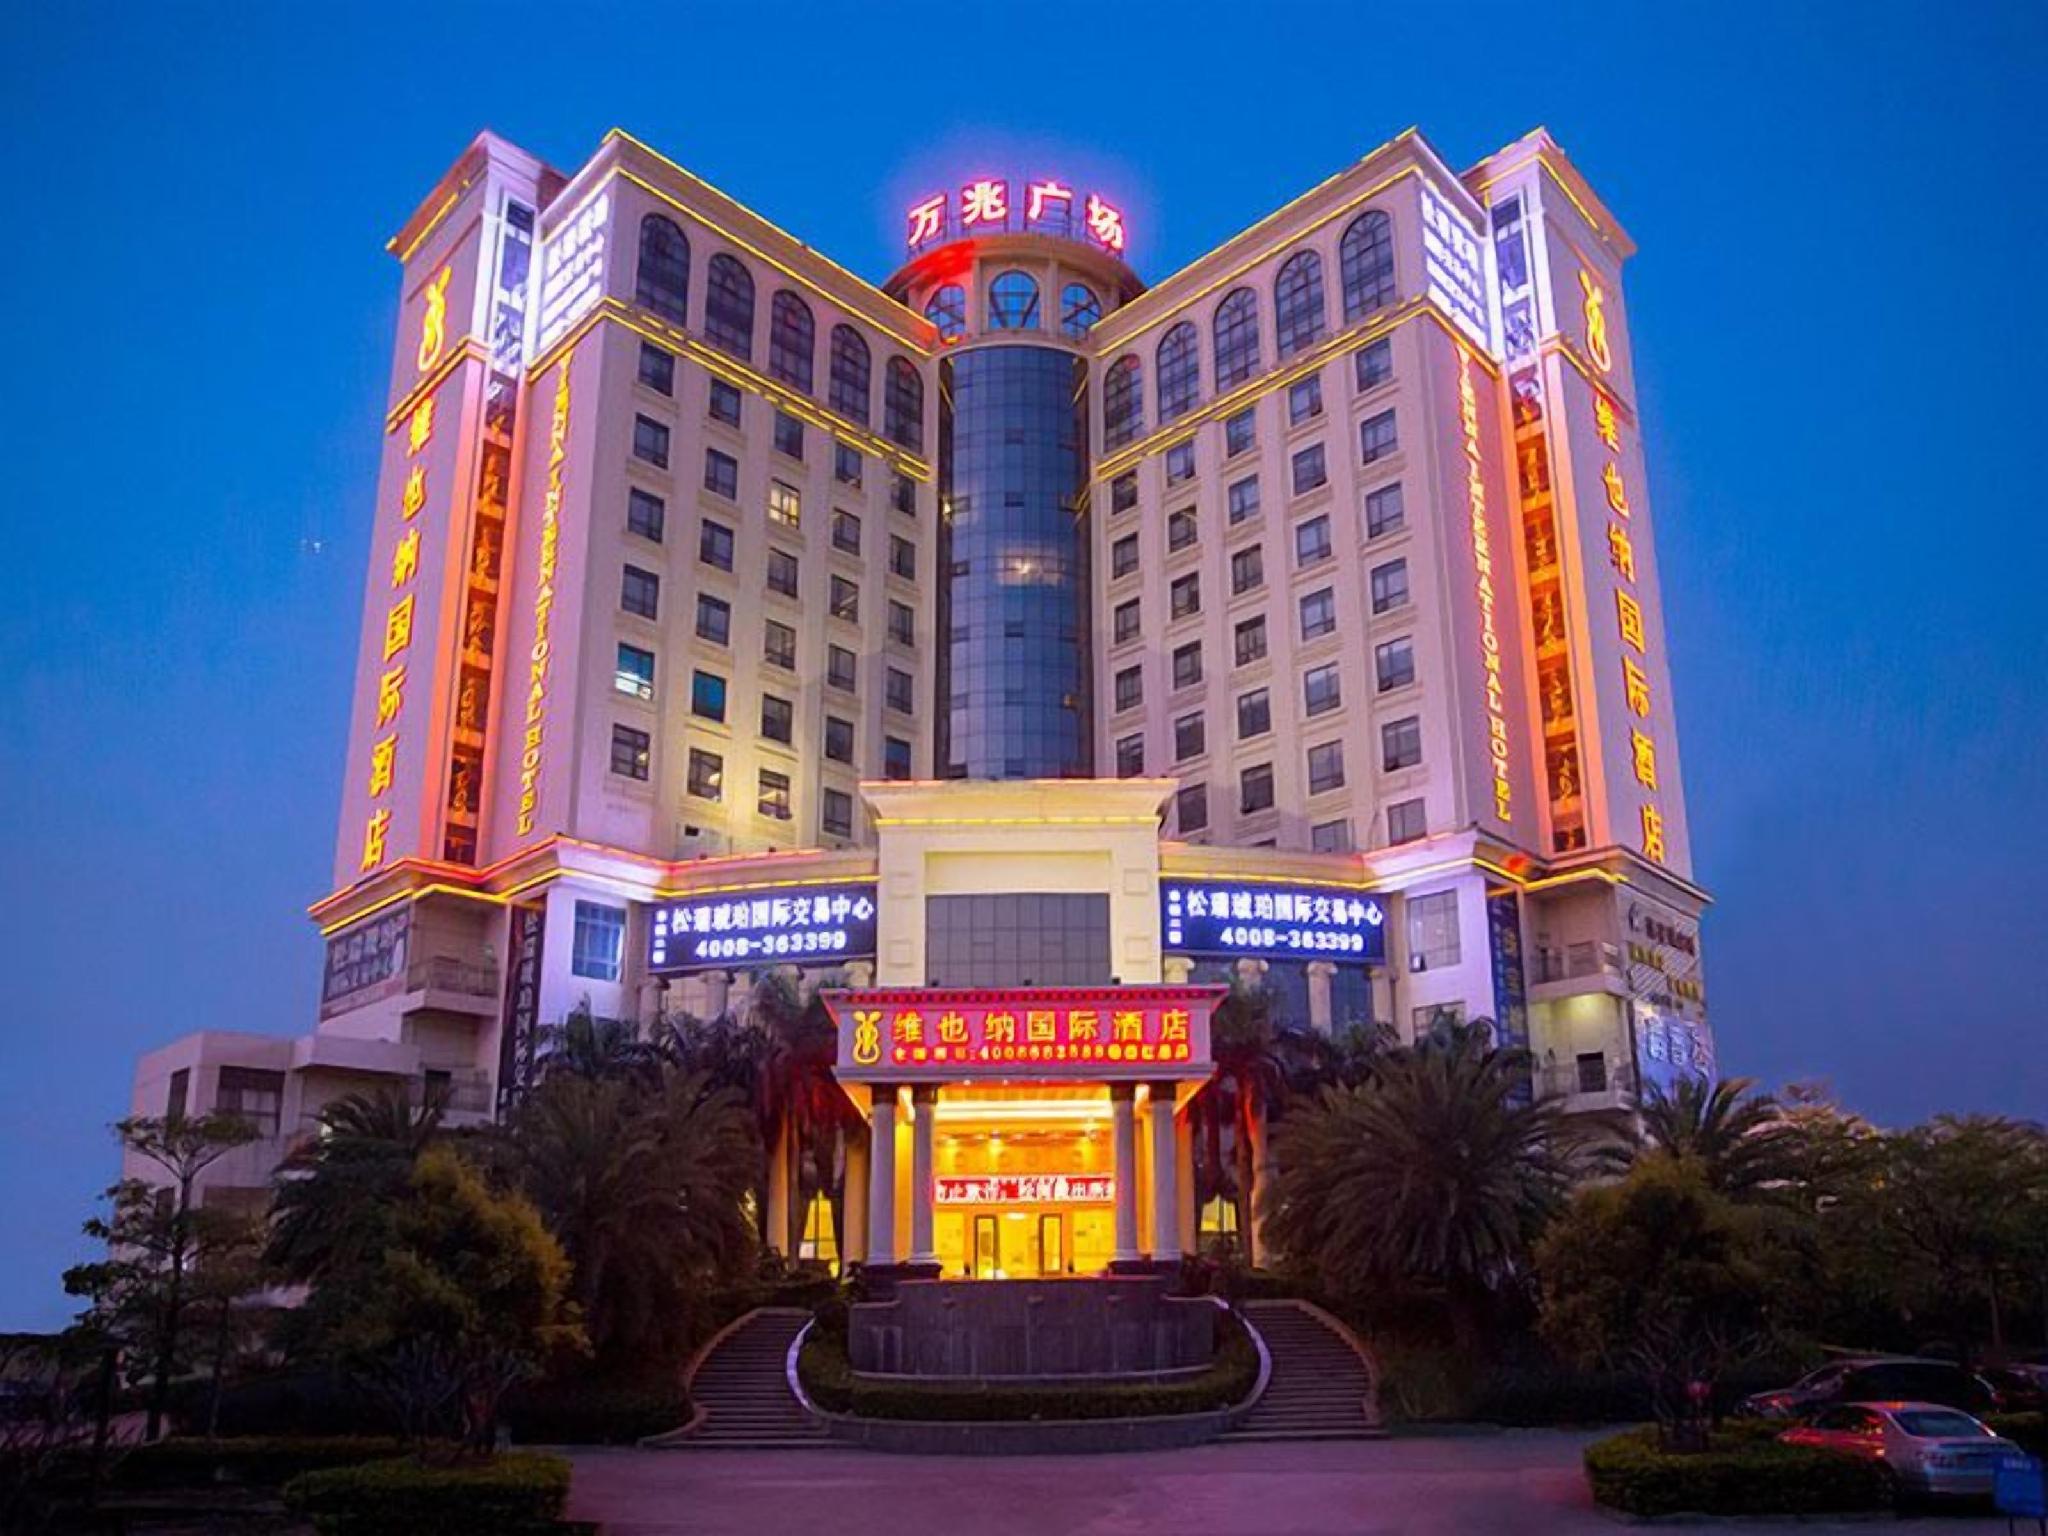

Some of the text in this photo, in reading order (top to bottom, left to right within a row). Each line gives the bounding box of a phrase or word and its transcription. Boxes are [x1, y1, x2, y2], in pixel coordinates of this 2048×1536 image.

[907, 180, 1125, 250] 万兆广场
[893, 1008, 1189, 1042] 维也纳国际酒店
